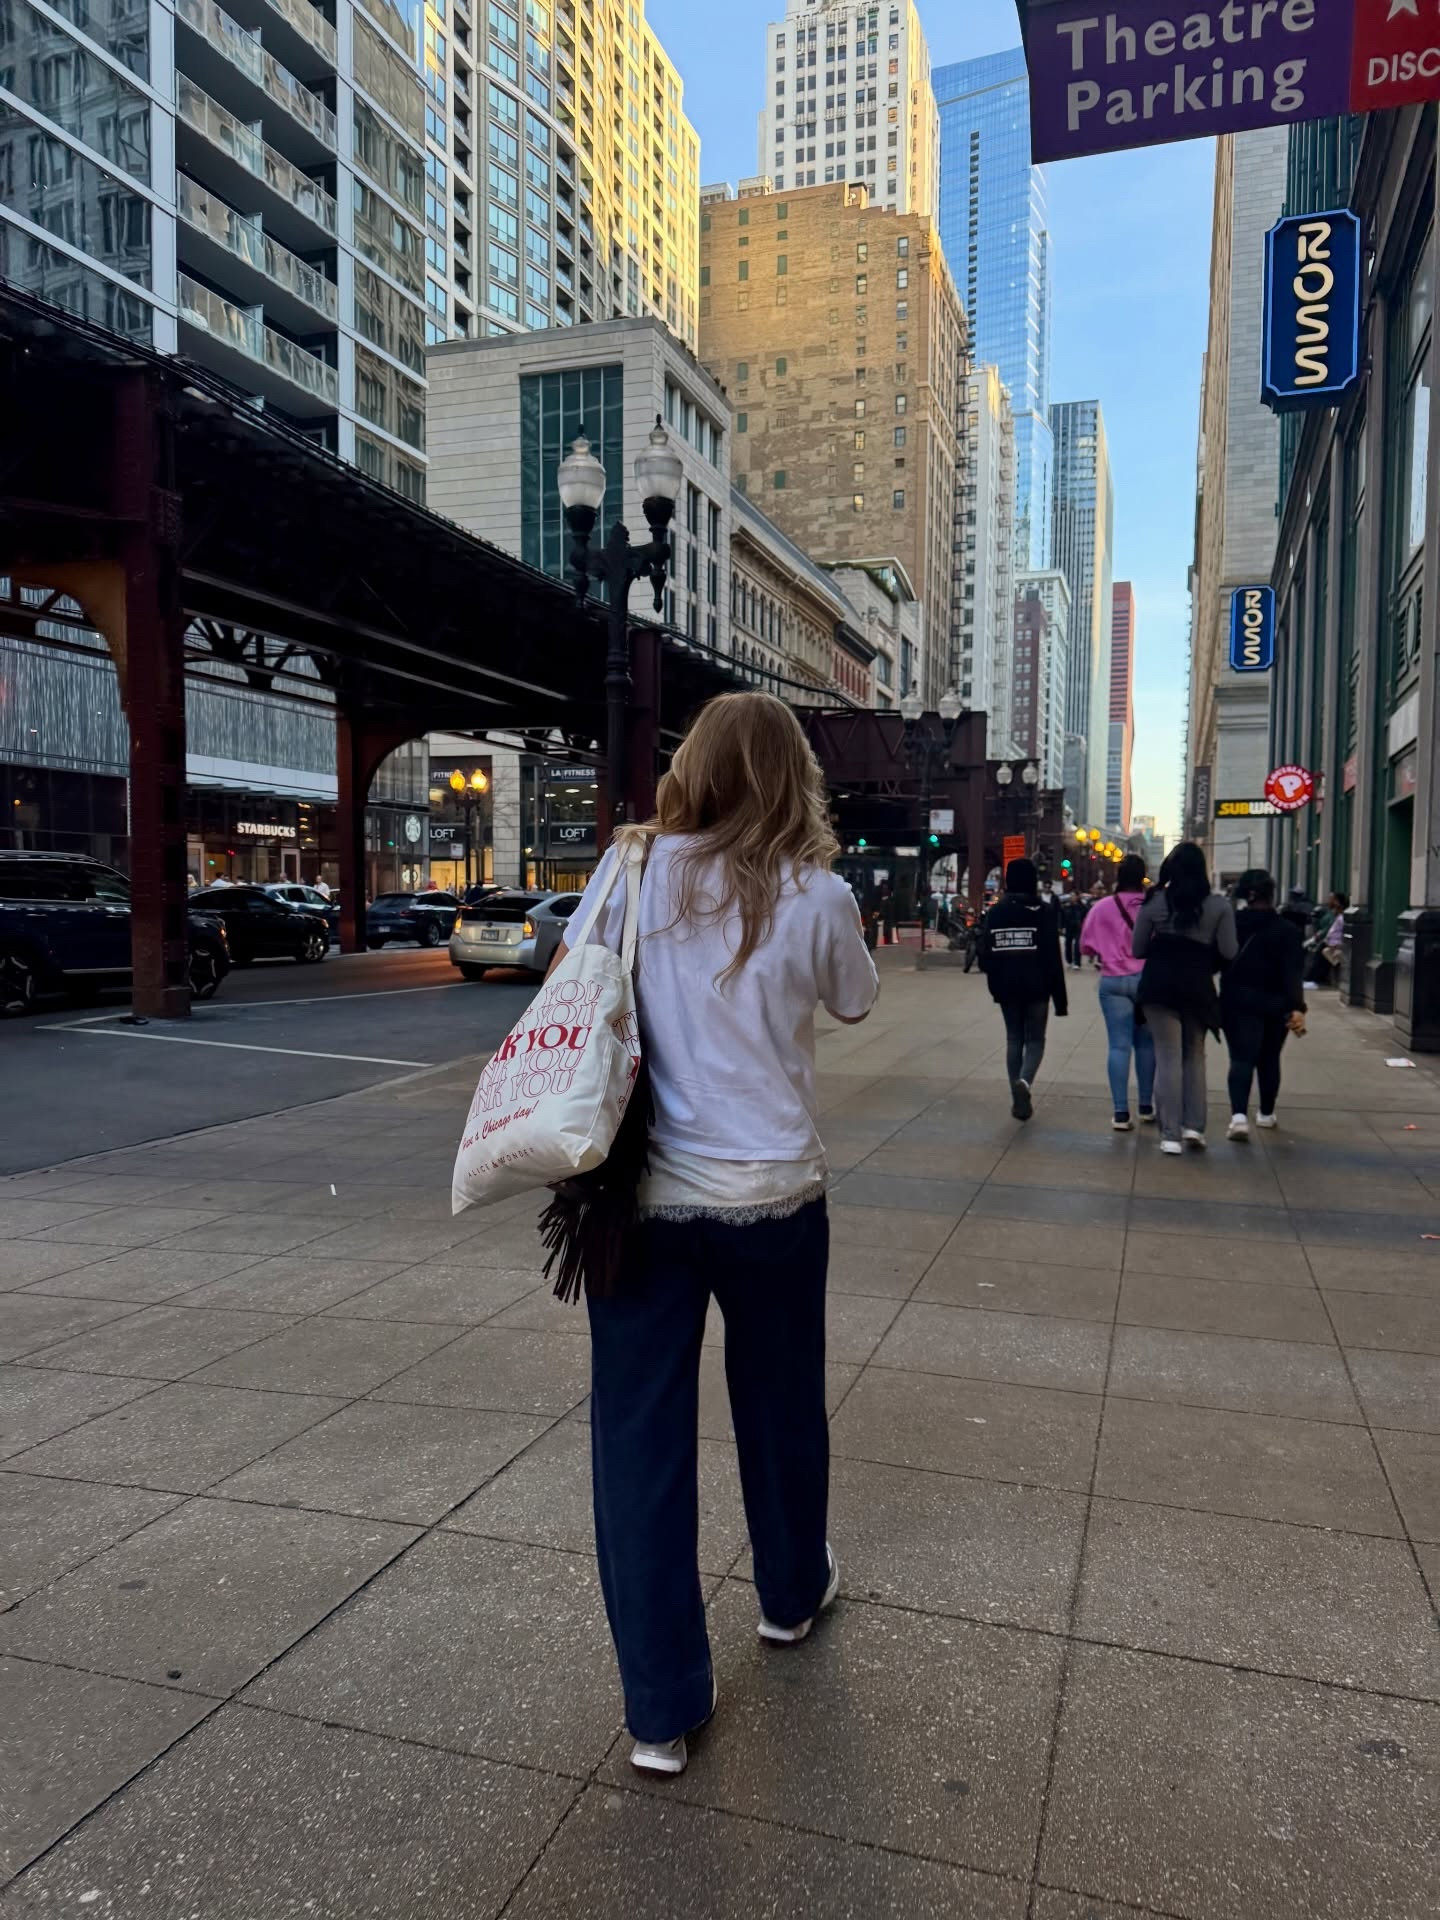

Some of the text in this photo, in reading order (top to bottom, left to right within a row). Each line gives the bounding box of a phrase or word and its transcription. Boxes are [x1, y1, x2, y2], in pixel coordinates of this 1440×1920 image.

[1056, 0, 1315, 71] Theatre
[1067, 57, 1307, 131] Parking
[1293, 221, 1334, 386] ROSS
[1242, 590, 1263, 665] ROSS
[551, 769, 596, 777] LA FITNESS
[237, 822, 296, 837] STARBUCKS
[430, 828, 456, 839] LOFT
[559, 828, 587, 838] LOFT
[544, 980, 604, 1006] YOU
[536, 1002, 598, 1028] YOU
[526, 1024, 592, 1053] YOU
[519, 1048, 585, 1075] YOU
[510, 1070, 576, 1101] YOU
[482, 1116, 511, 1139] Chicago
[513, 1100, 539, 1119] day!
[468, 1163, 490, 1178] ALICE
[491, 1160, 498, 1168] &
